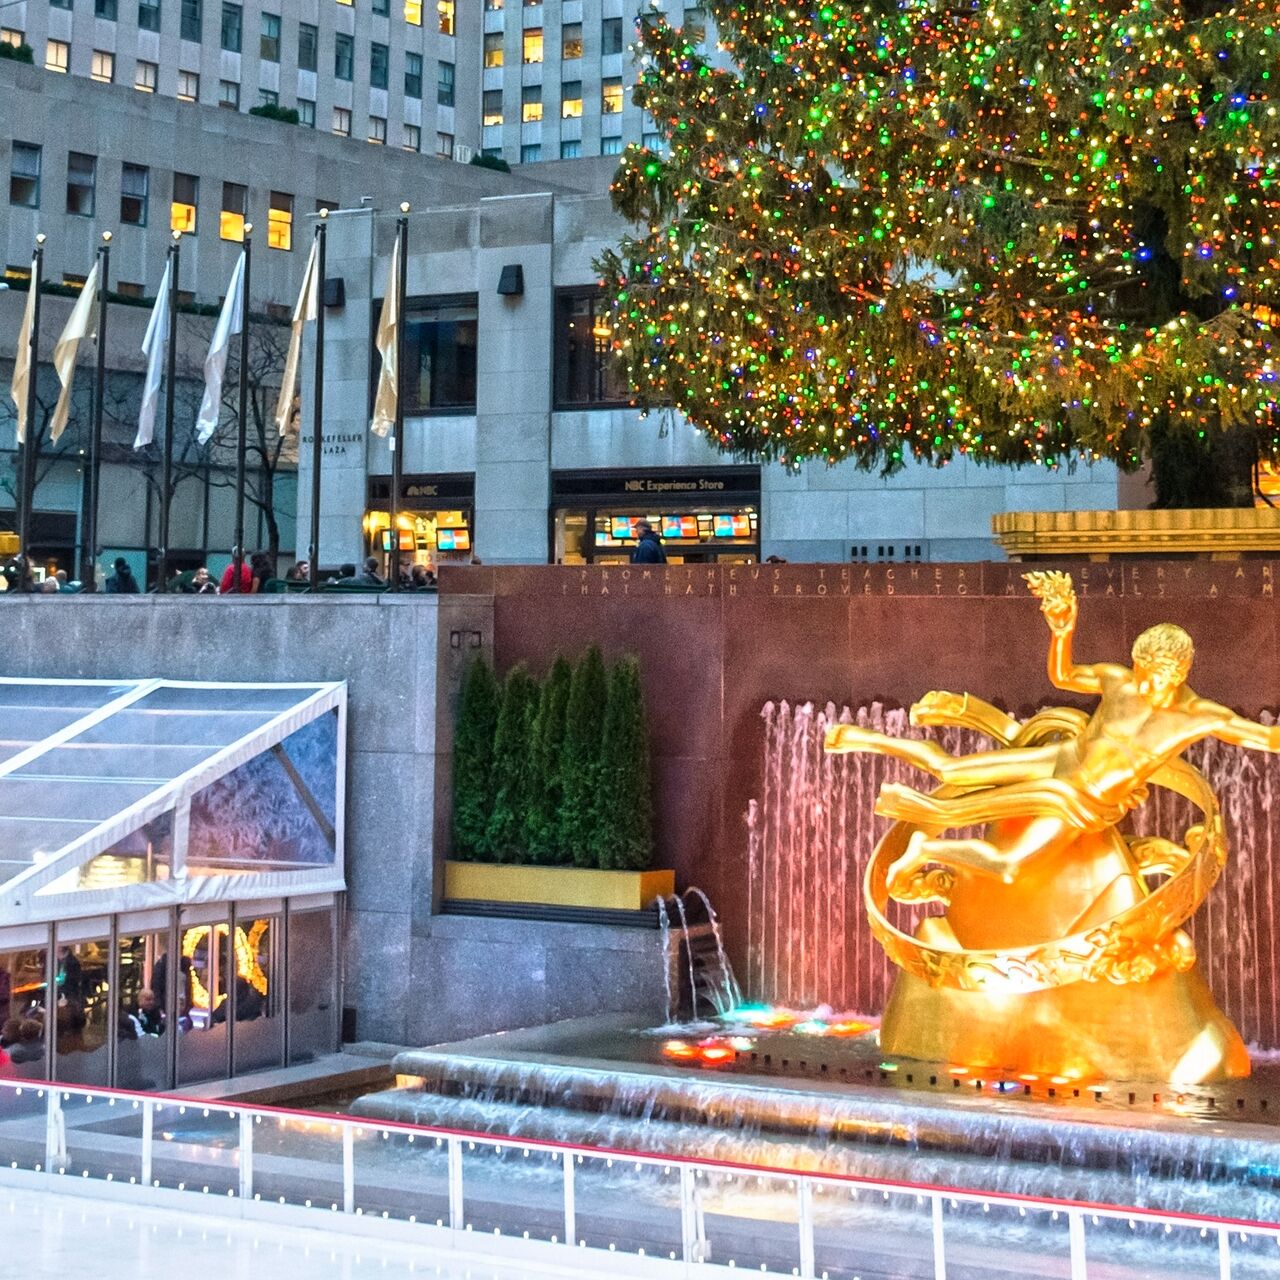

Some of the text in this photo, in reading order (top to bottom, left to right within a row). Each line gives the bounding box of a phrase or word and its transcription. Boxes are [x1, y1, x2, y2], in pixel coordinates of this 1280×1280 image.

[302, 434, 362, 443] ROKEFELLER
[624, 478, 724, 492] NBC Experience Store
[581, 568, 781, 581] PROMETHEUS
[818, 568, 965, 580] TEACHER
[1081, 567, 1192, 579] EVERY
[560, 583, 630, 595] THAT
[664, 583, 738, 596] HATH
[772, 583, 896, 595] PROVED
[935, 583, 968, 595] TO
[1005, 583, 1166, 595] MTALS
[1208, 583, 1219, 595] A
